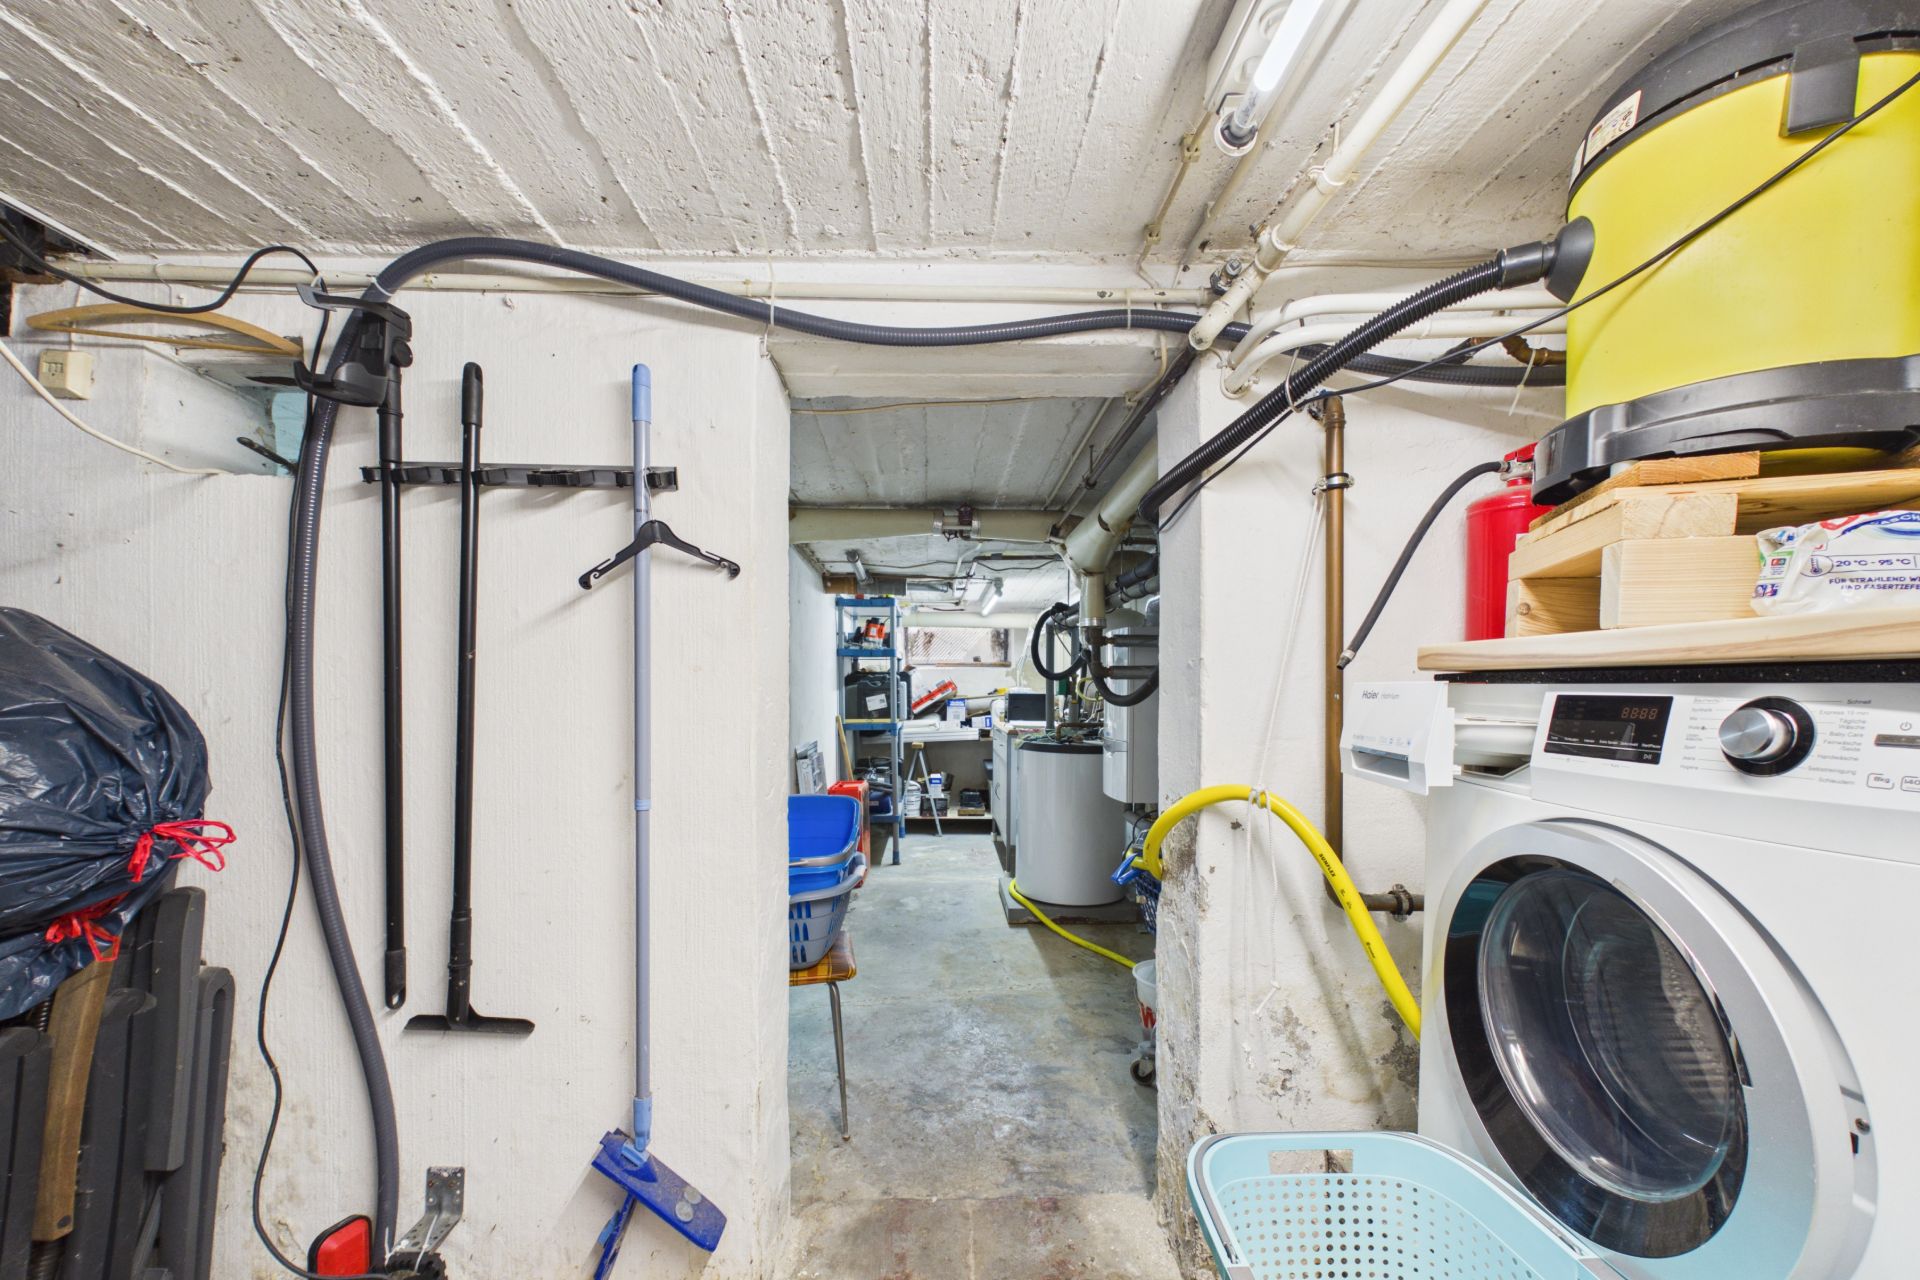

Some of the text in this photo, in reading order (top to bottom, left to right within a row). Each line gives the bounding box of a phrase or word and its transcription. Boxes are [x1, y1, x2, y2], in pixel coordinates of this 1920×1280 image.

[1853, 559, 1868, 567] °C
[1878, 559, 1894, 567] 95
[1896, 558, 1911, 566] °C
[1829, 577, 1847, 585] FÜR
[1362, 690, 1379, 700] Haier
